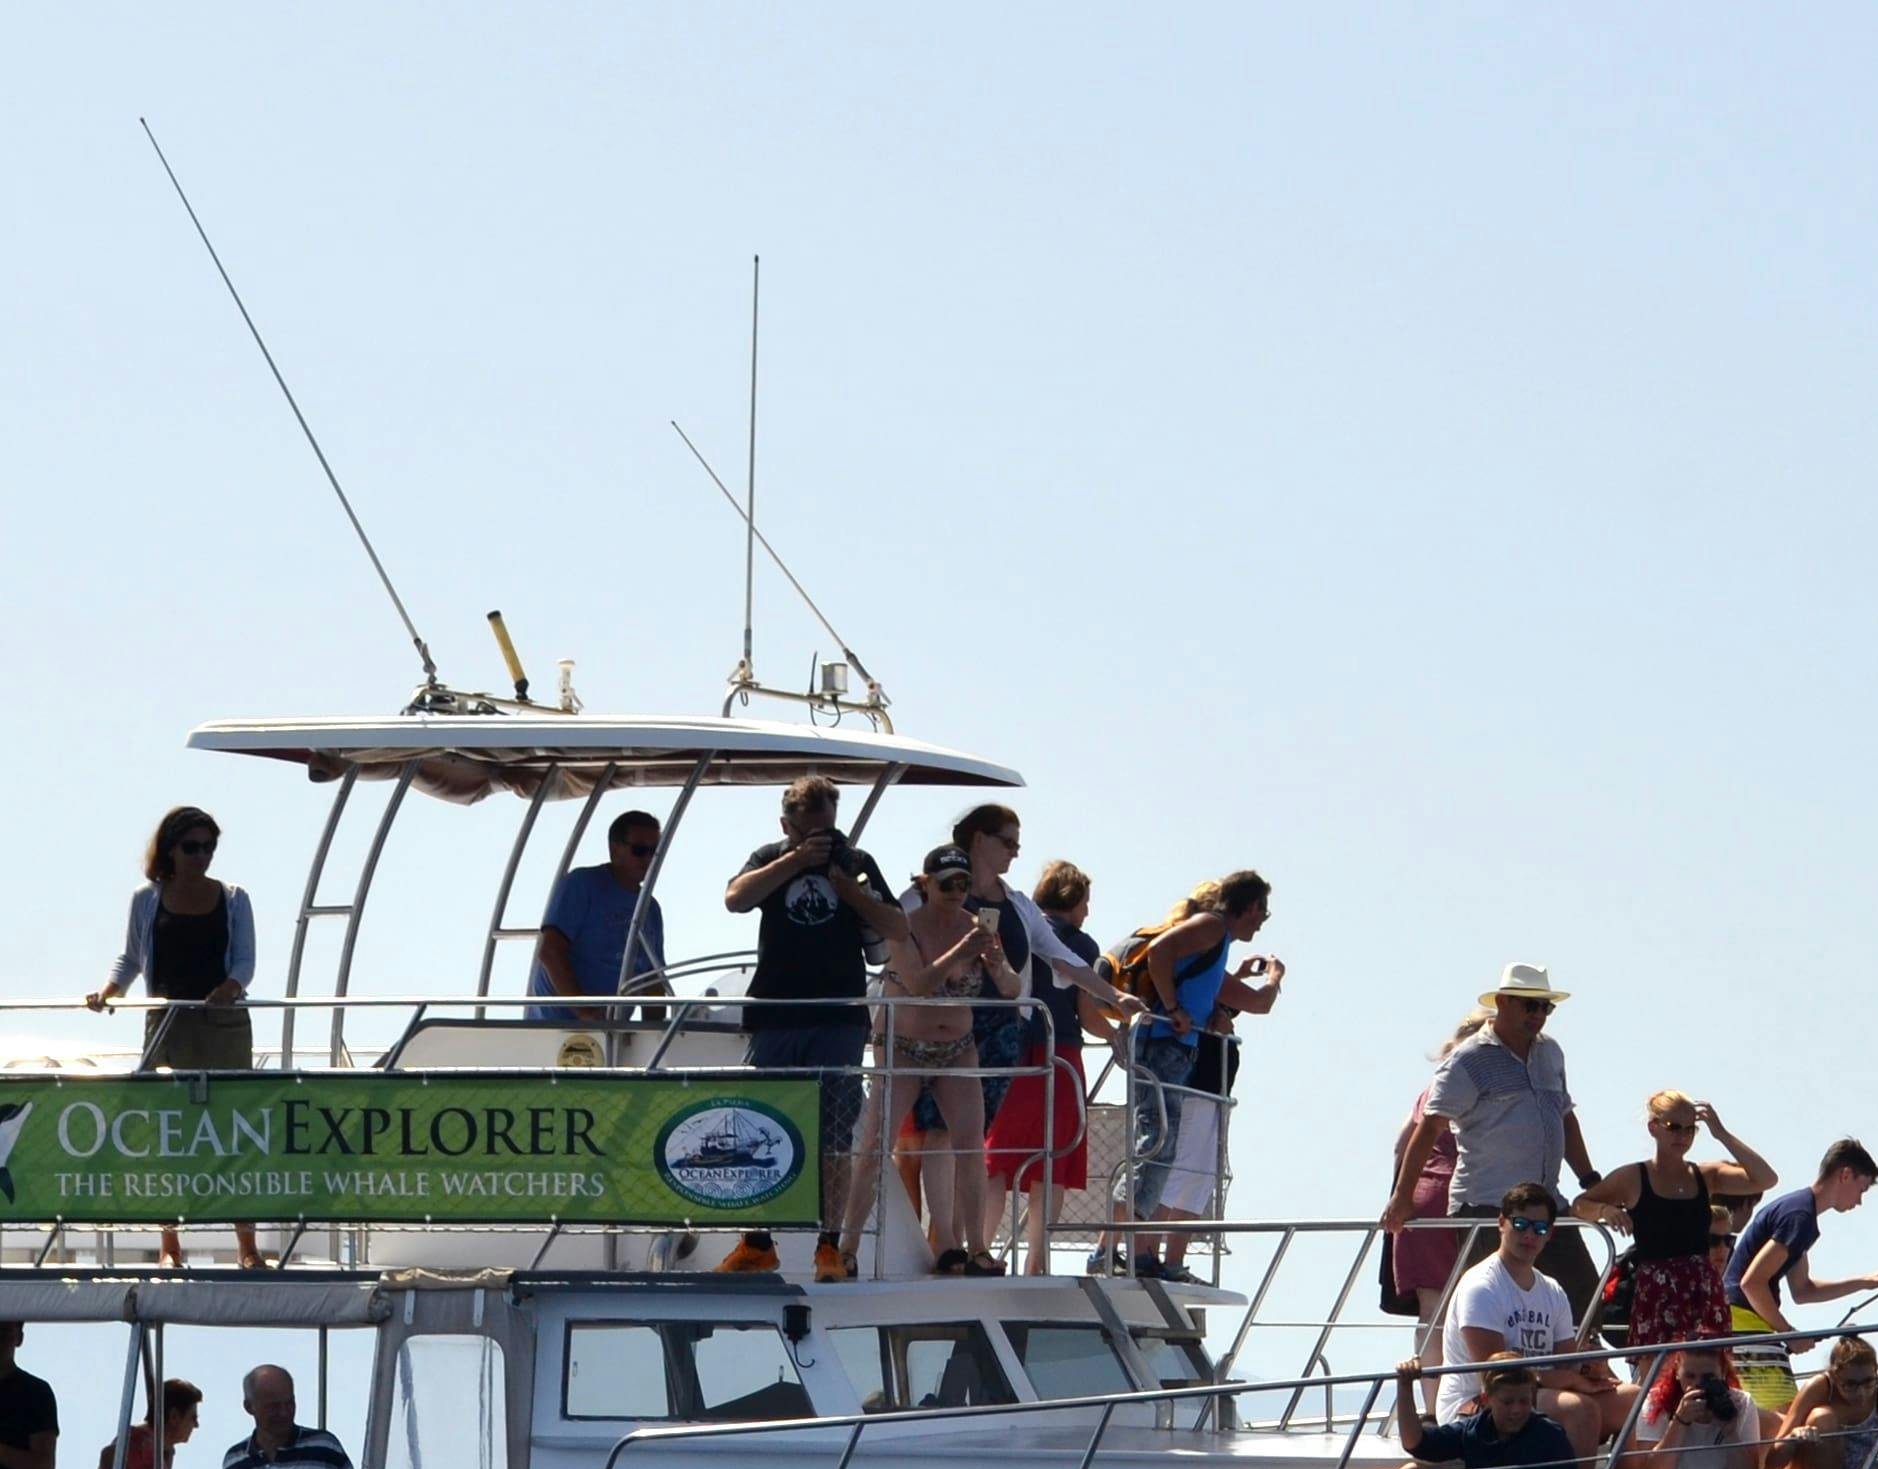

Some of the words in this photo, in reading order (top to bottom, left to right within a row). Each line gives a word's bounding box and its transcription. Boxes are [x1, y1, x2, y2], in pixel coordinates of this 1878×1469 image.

[57, 1099, 607, 1158] OCEANEXPLORER
[54, 1172, 113, 1197] THE
[123, 1171, 313, 1198] RESPONSIBLE
[323, 1170, 430, 1197] WHALE
[440, 1170, 605, 1198] WATCHERS
[679, 1168, 782, 1181] OCEANEXPLRER
